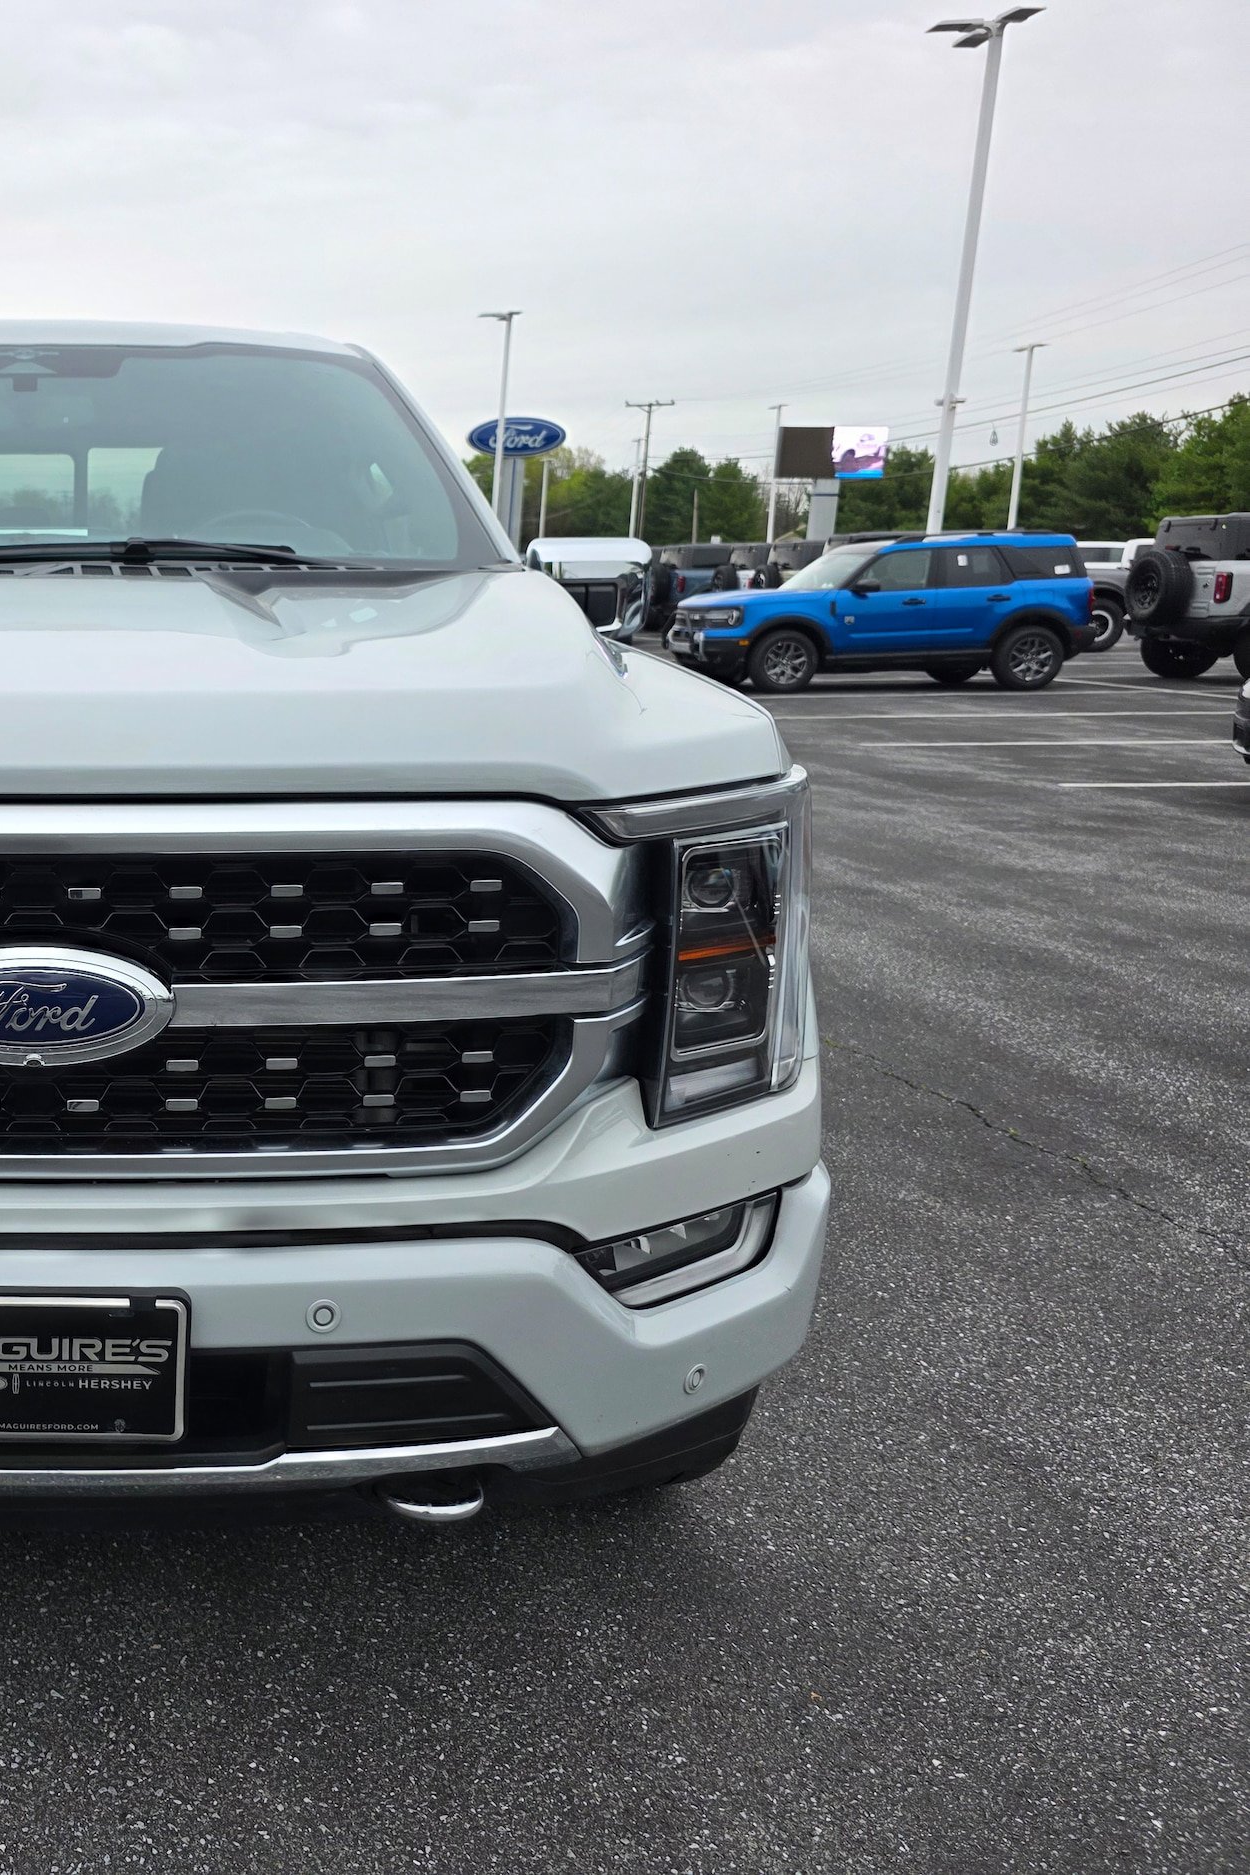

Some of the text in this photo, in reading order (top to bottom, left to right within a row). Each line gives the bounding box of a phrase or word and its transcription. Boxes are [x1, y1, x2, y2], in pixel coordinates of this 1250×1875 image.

[8, 1363, 94, 1373] MEANS MORE
[78, 1379, 152, 1390] HERSHEY
